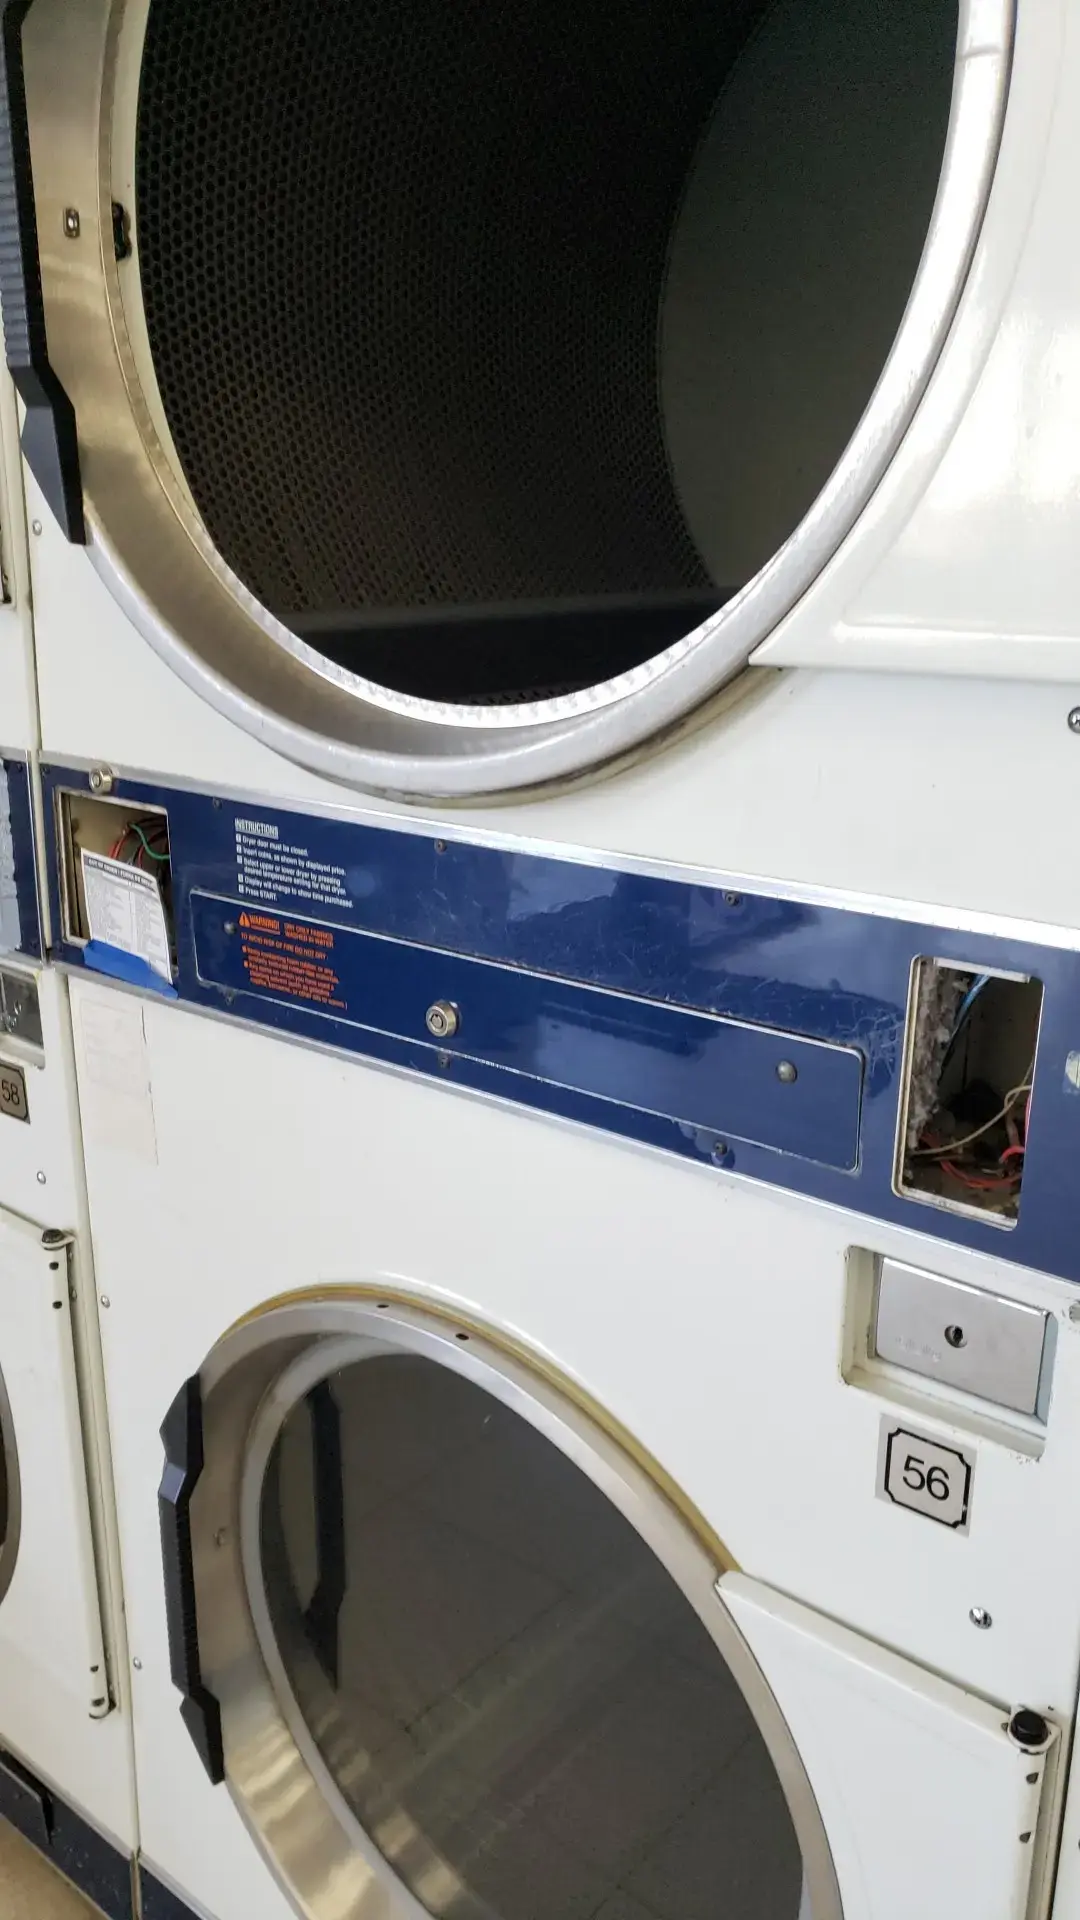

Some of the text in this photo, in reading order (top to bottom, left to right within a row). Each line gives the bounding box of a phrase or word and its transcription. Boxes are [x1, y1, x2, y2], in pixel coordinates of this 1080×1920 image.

[235, 817, 278, 839] INSTRUCTIONS
[242, 835, 256, 846] Dryer
[257, 839, 269, 848] door
[270, 842, 282, 851] must
[283, 844, 289, 853] be
[260, 861, 274, 872] upper
[281, 864, 295, 875] lower
[296, 869, 309, 880] dryer
[311, 872, 317, 882] by
[318, 874, 340, 887] pressing
[281, 855, 297, 866] shown
[298, 858, 304, 868] by
[306, 861, 330, 873] displayed
[245, 878, 262, 888] Display
[263, 880, 271, 889] will
[272, 883, 290, 894] change
[298, 889, 311, 899] show
[312, 892, 324, 902] time
[245, 887, 259, 897] Press
[263, 870, 292, 883] temperature
[320, 882, 330, 892] that
[2, 1080, 20, 1106] 58
[902, 1454, 950, 1502] 56
